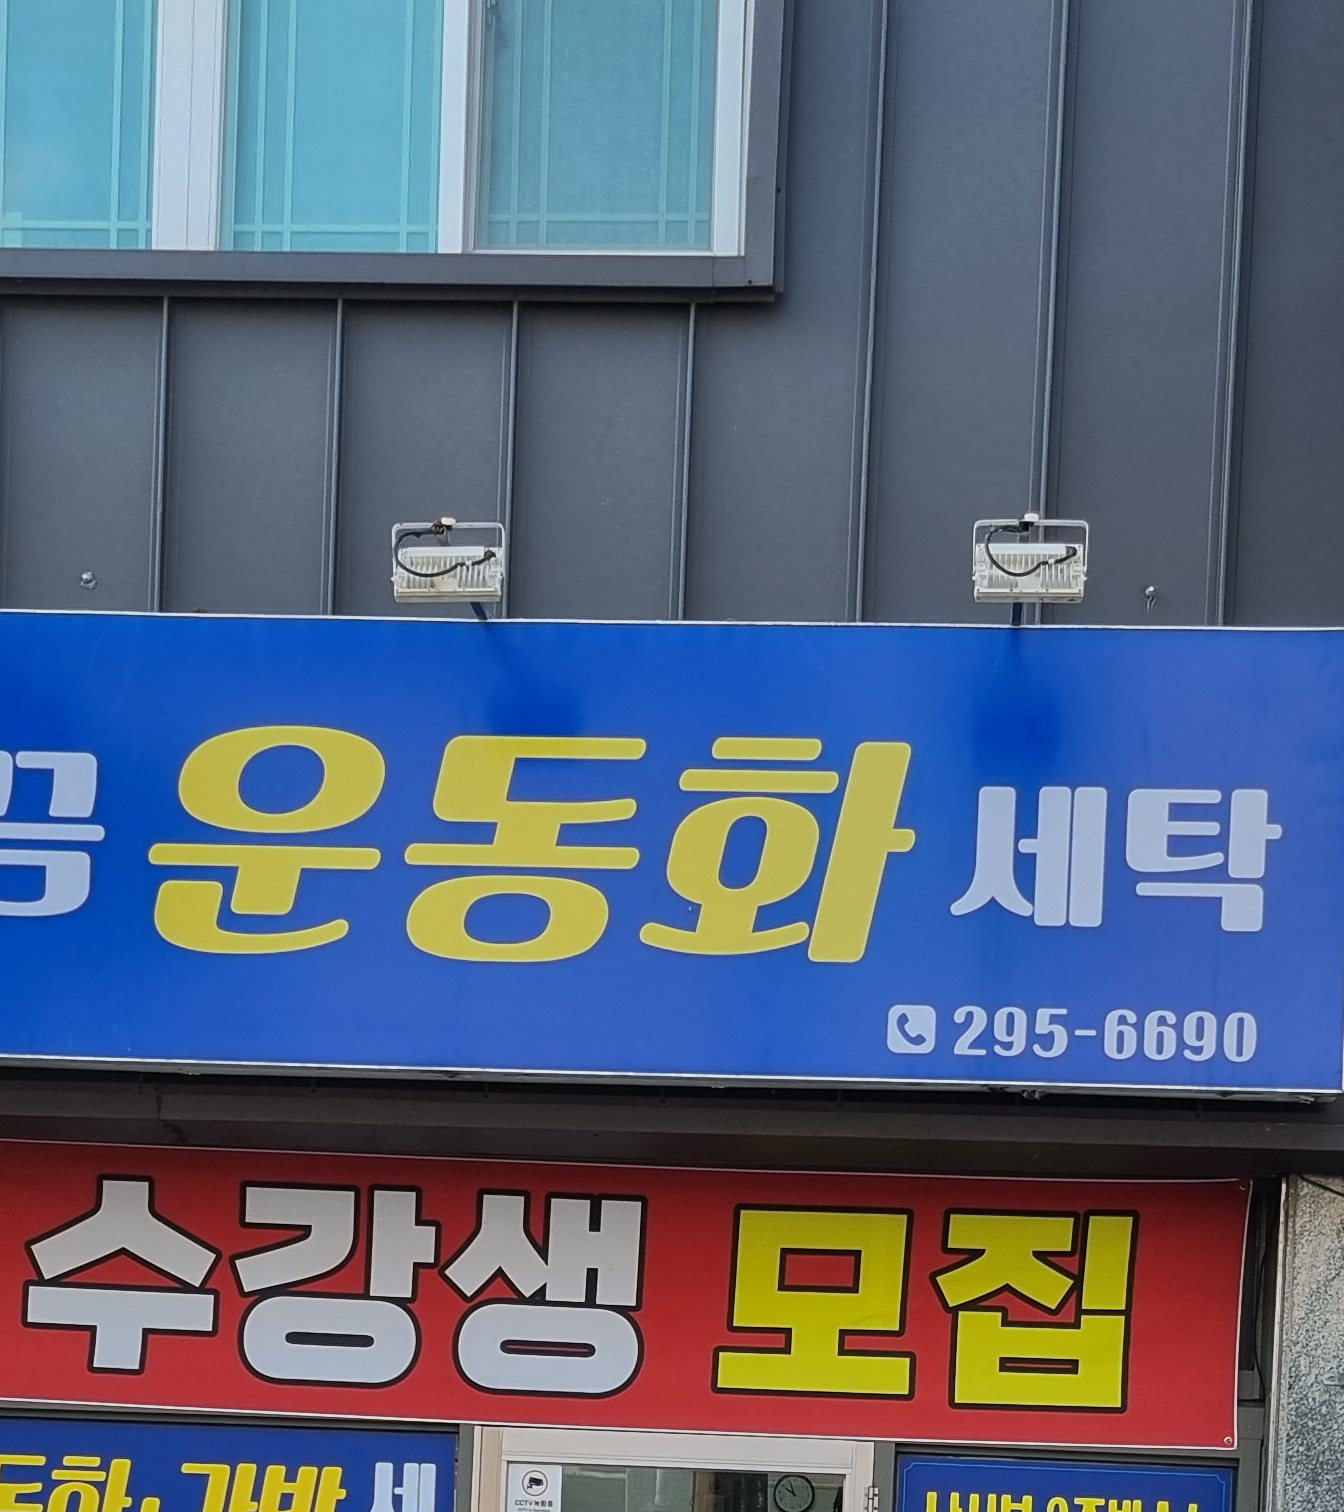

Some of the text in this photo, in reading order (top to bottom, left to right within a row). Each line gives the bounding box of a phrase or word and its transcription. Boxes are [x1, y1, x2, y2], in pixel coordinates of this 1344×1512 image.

[148, 724, 916, 964] 운동화
[949, 786, 1283, 933] 세탁
[953, 1005, 1258, 1063] 295-6690
[24, 1174, 1141, 1412] 수강생 모집
[514, 1499, 534, 1507] CCTV
